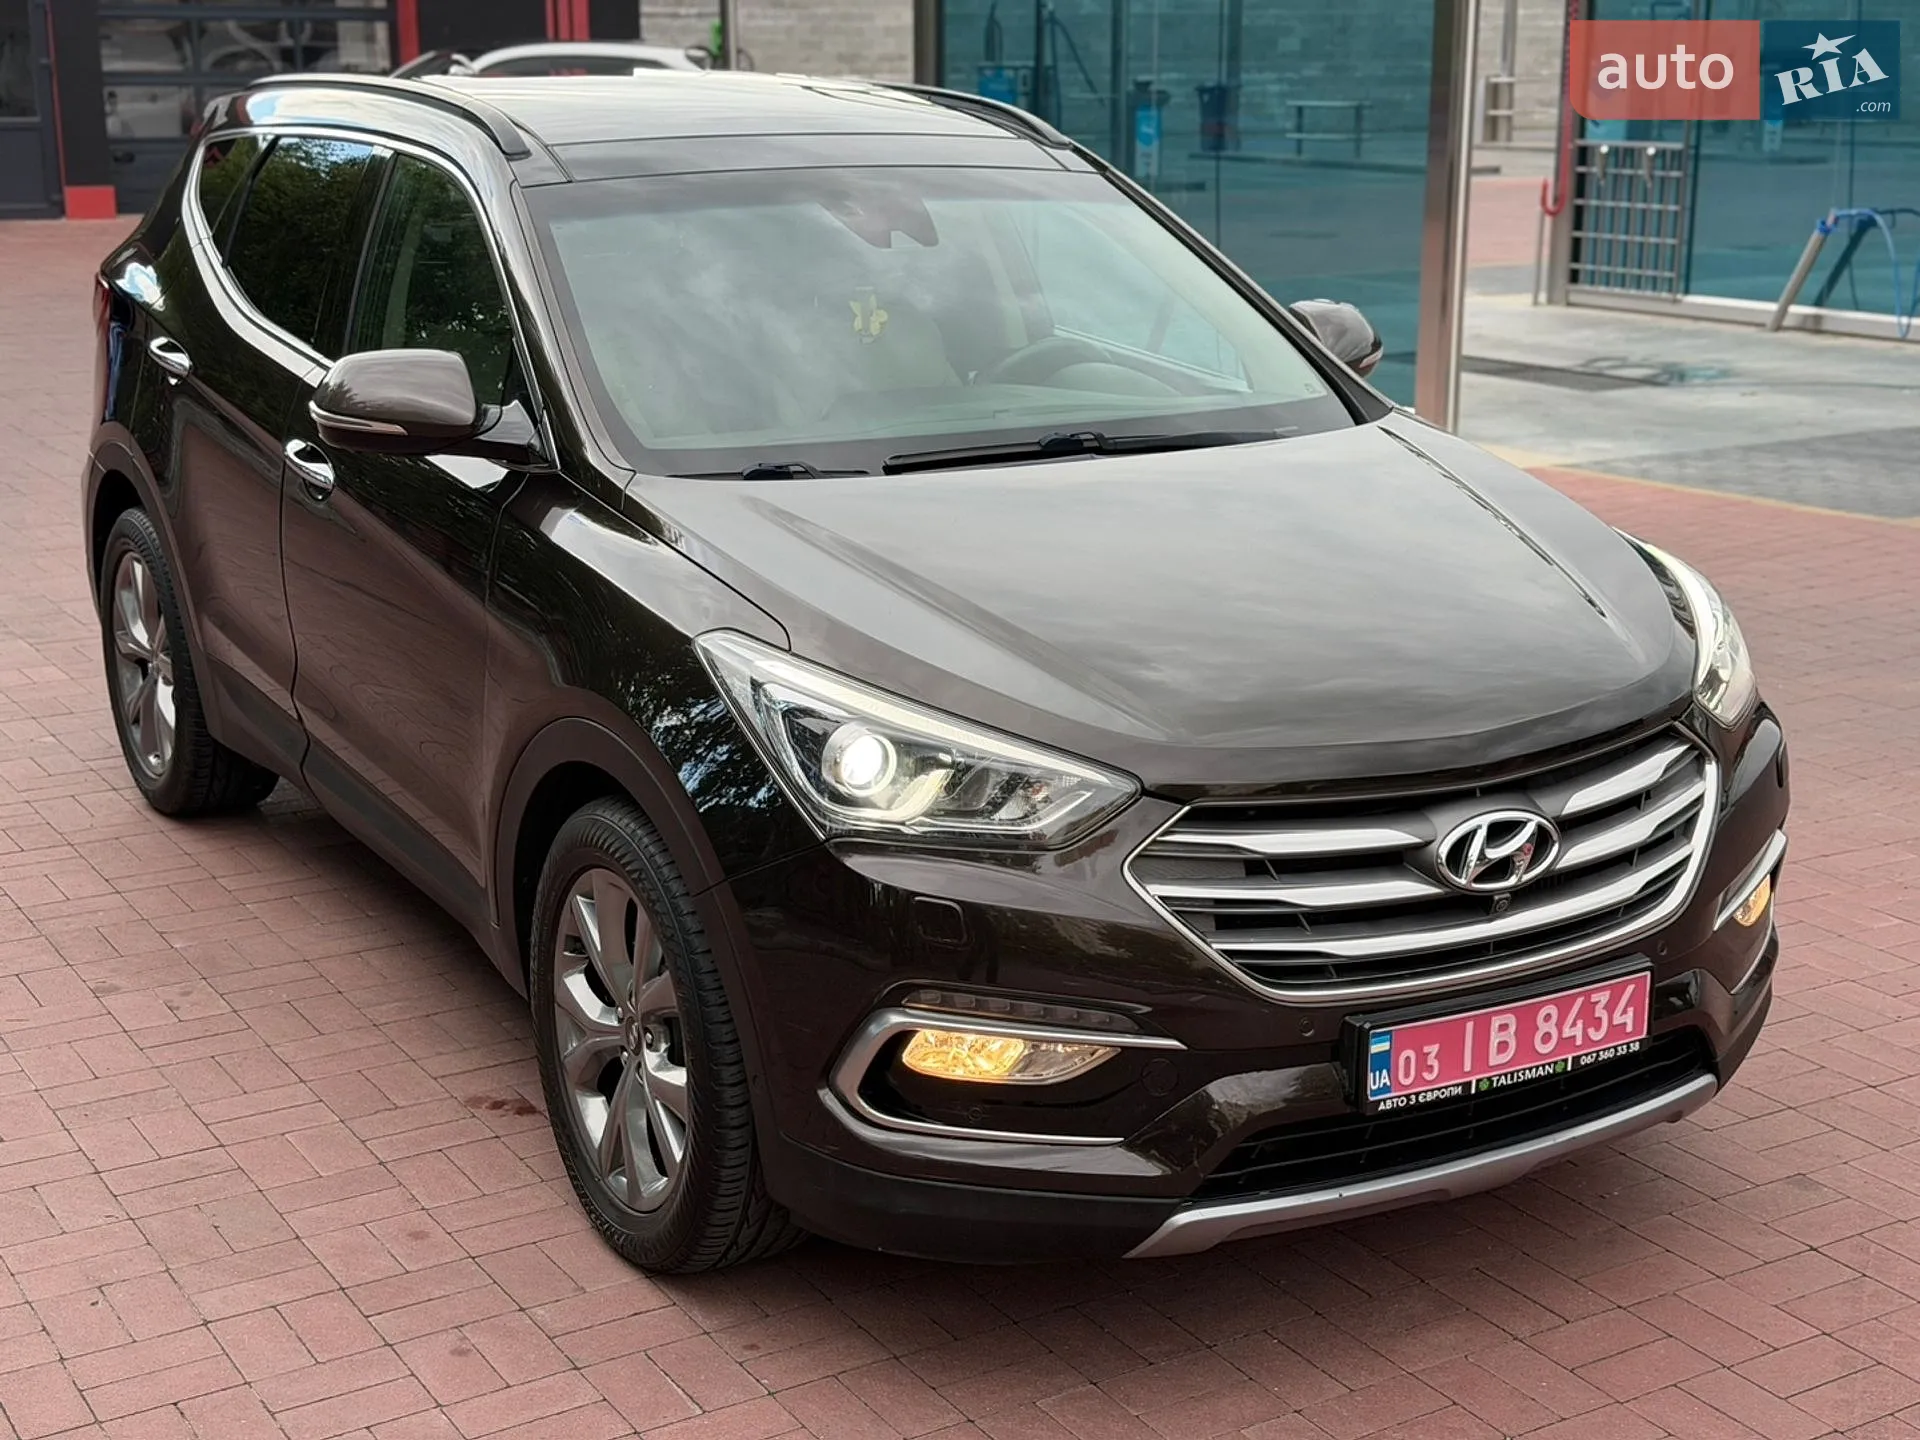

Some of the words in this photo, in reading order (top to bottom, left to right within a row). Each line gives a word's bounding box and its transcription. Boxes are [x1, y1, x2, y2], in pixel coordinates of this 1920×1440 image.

[1398, 1044, 1440, 1086] 03
[1533, 983, 1636, 1054] 8434
[1580, 1054, 1596, 1065] 067
[1370, 1070, 1391, 1090] UA
[1491, 1063, 1555, 1088] TALISMAN
[1378, 1096, 1407, 1111] АВТО
